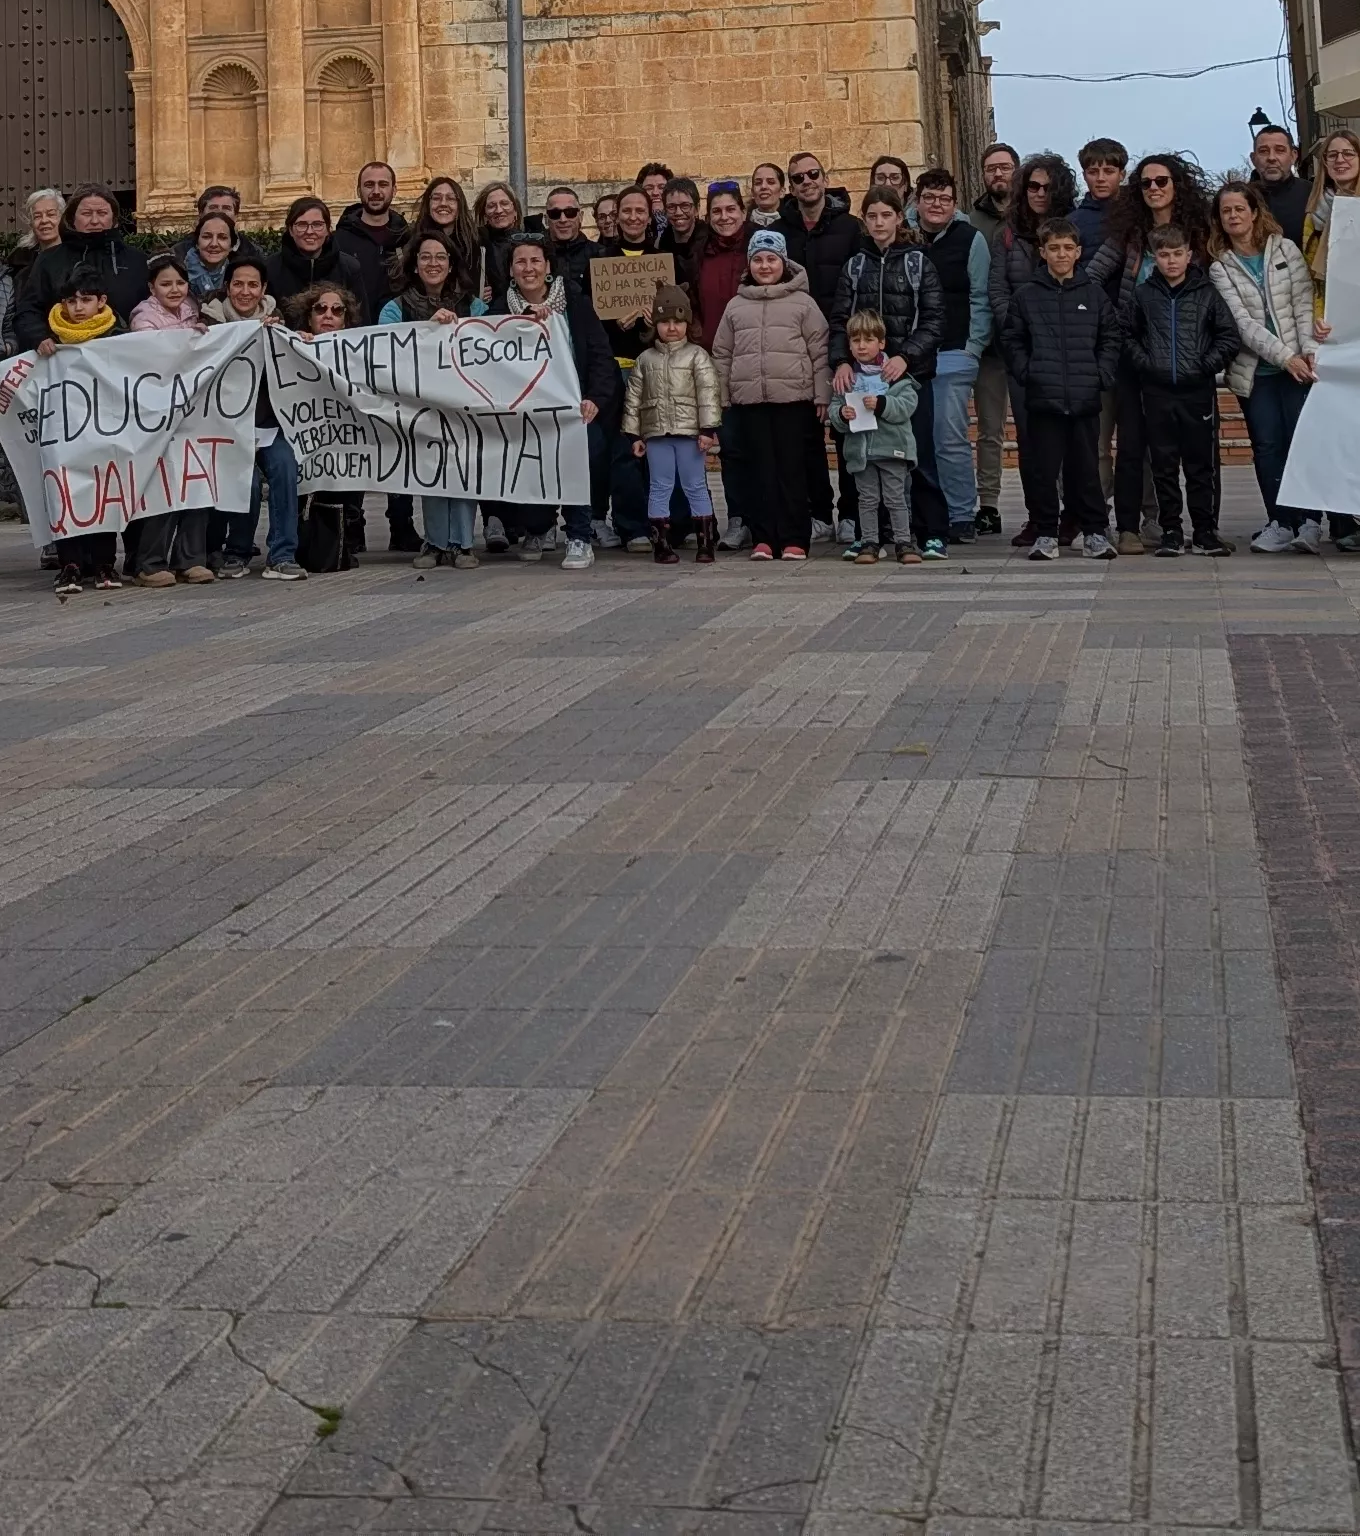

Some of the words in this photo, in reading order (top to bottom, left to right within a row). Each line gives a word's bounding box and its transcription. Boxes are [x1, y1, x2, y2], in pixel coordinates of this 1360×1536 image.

[593, 263, 609, 277] LA
[596, 279, 611, 292] NO
[616, 280, 630, 291] HA
[634, 278, 646, 288] DE
[266, 325, 420, 399] ESTIMEM
[438, 332, 553, 370] L'ESCOLA
[279, 397, 358, 428] VOLEM
[369, 401, 573, 500] DIGNITAT
[296, 451, 372, 485] BUSQUEM
